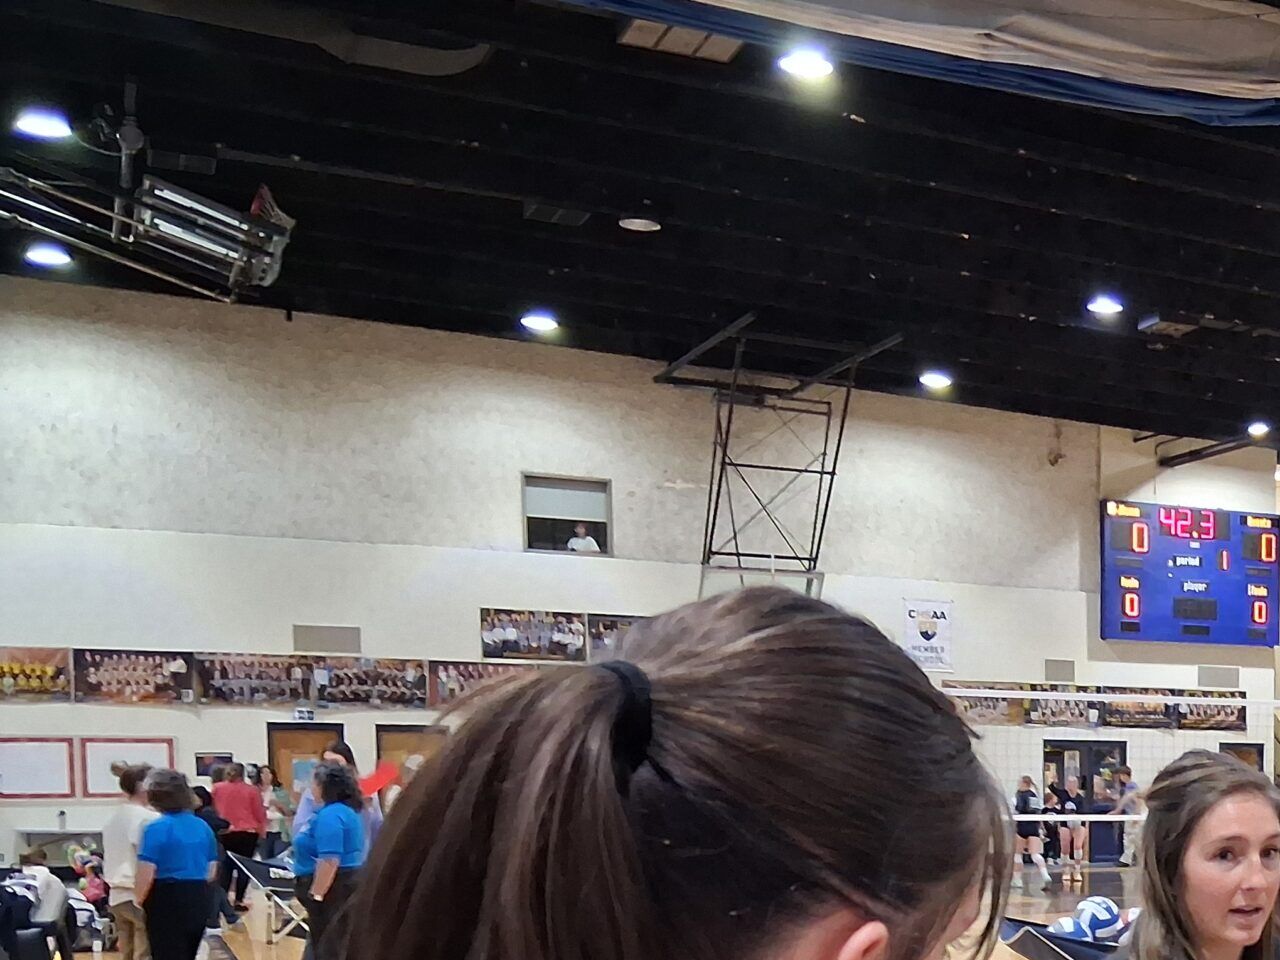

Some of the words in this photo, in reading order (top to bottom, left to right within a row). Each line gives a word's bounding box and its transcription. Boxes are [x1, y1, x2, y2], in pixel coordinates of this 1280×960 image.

[1132, 522, 1149, 552] 0
[1159, 507, 1214, 539] 42.3
[1261, 533, 1277, 562] 0
[1124, 592, 1140, 616] 0
[1253, 600, 1267, 624] 0
